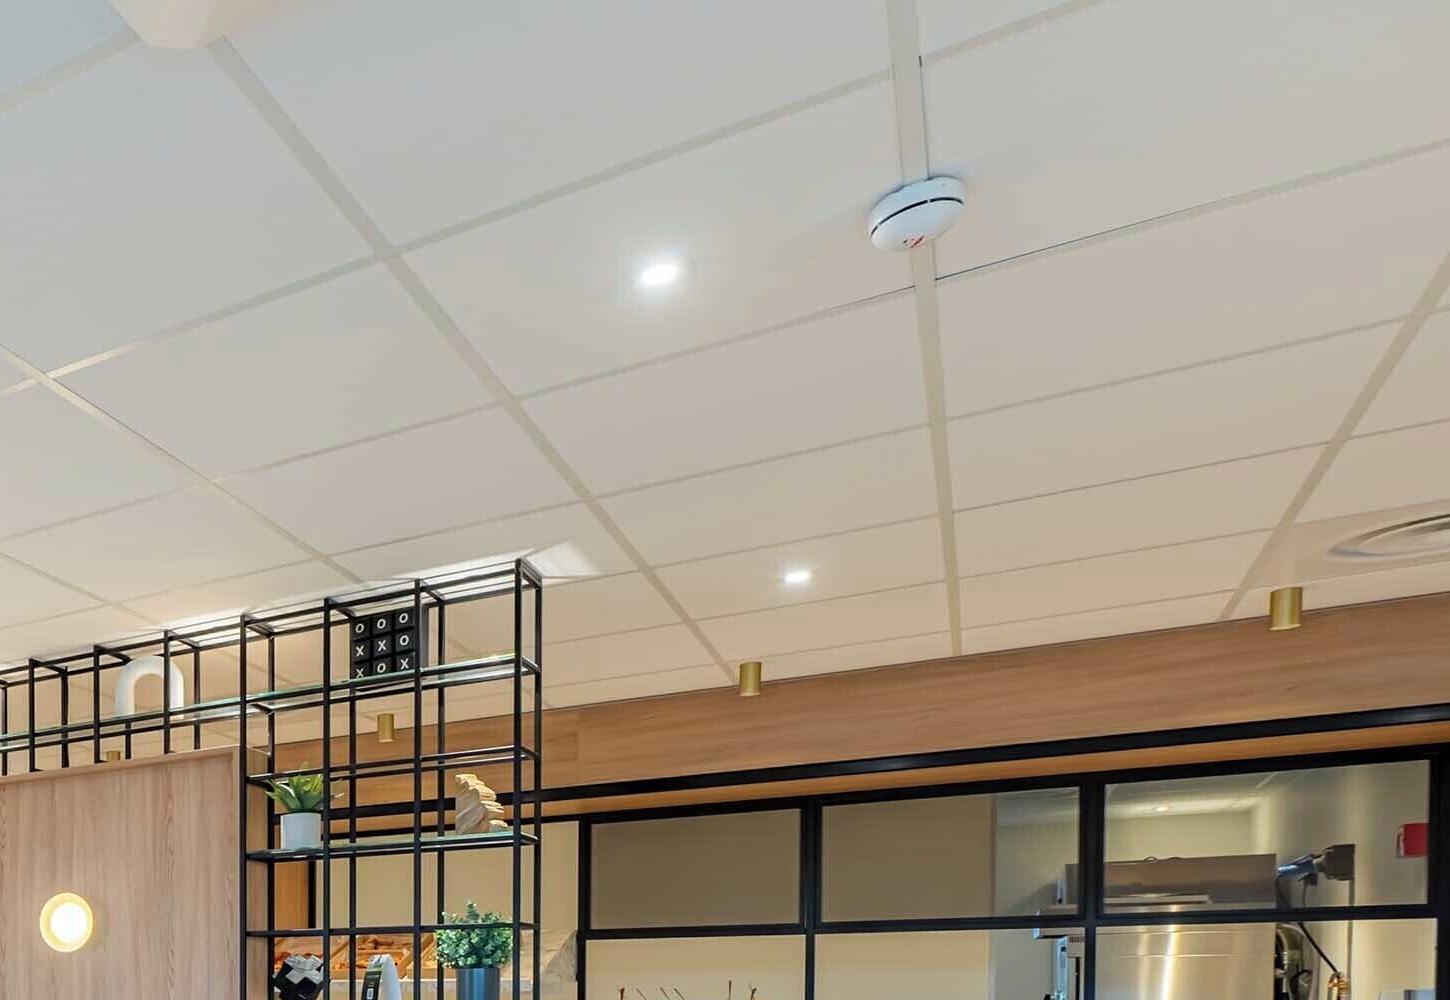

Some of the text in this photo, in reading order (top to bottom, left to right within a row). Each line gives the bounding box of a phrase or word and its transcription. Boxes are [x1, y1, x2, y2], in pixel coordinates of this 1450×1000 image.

[355, 613, 409, 633] O O O
[355, 635, 409, 657] X X O
[376, 663, 386, 673] O
[400, 658, 409, 670] X
